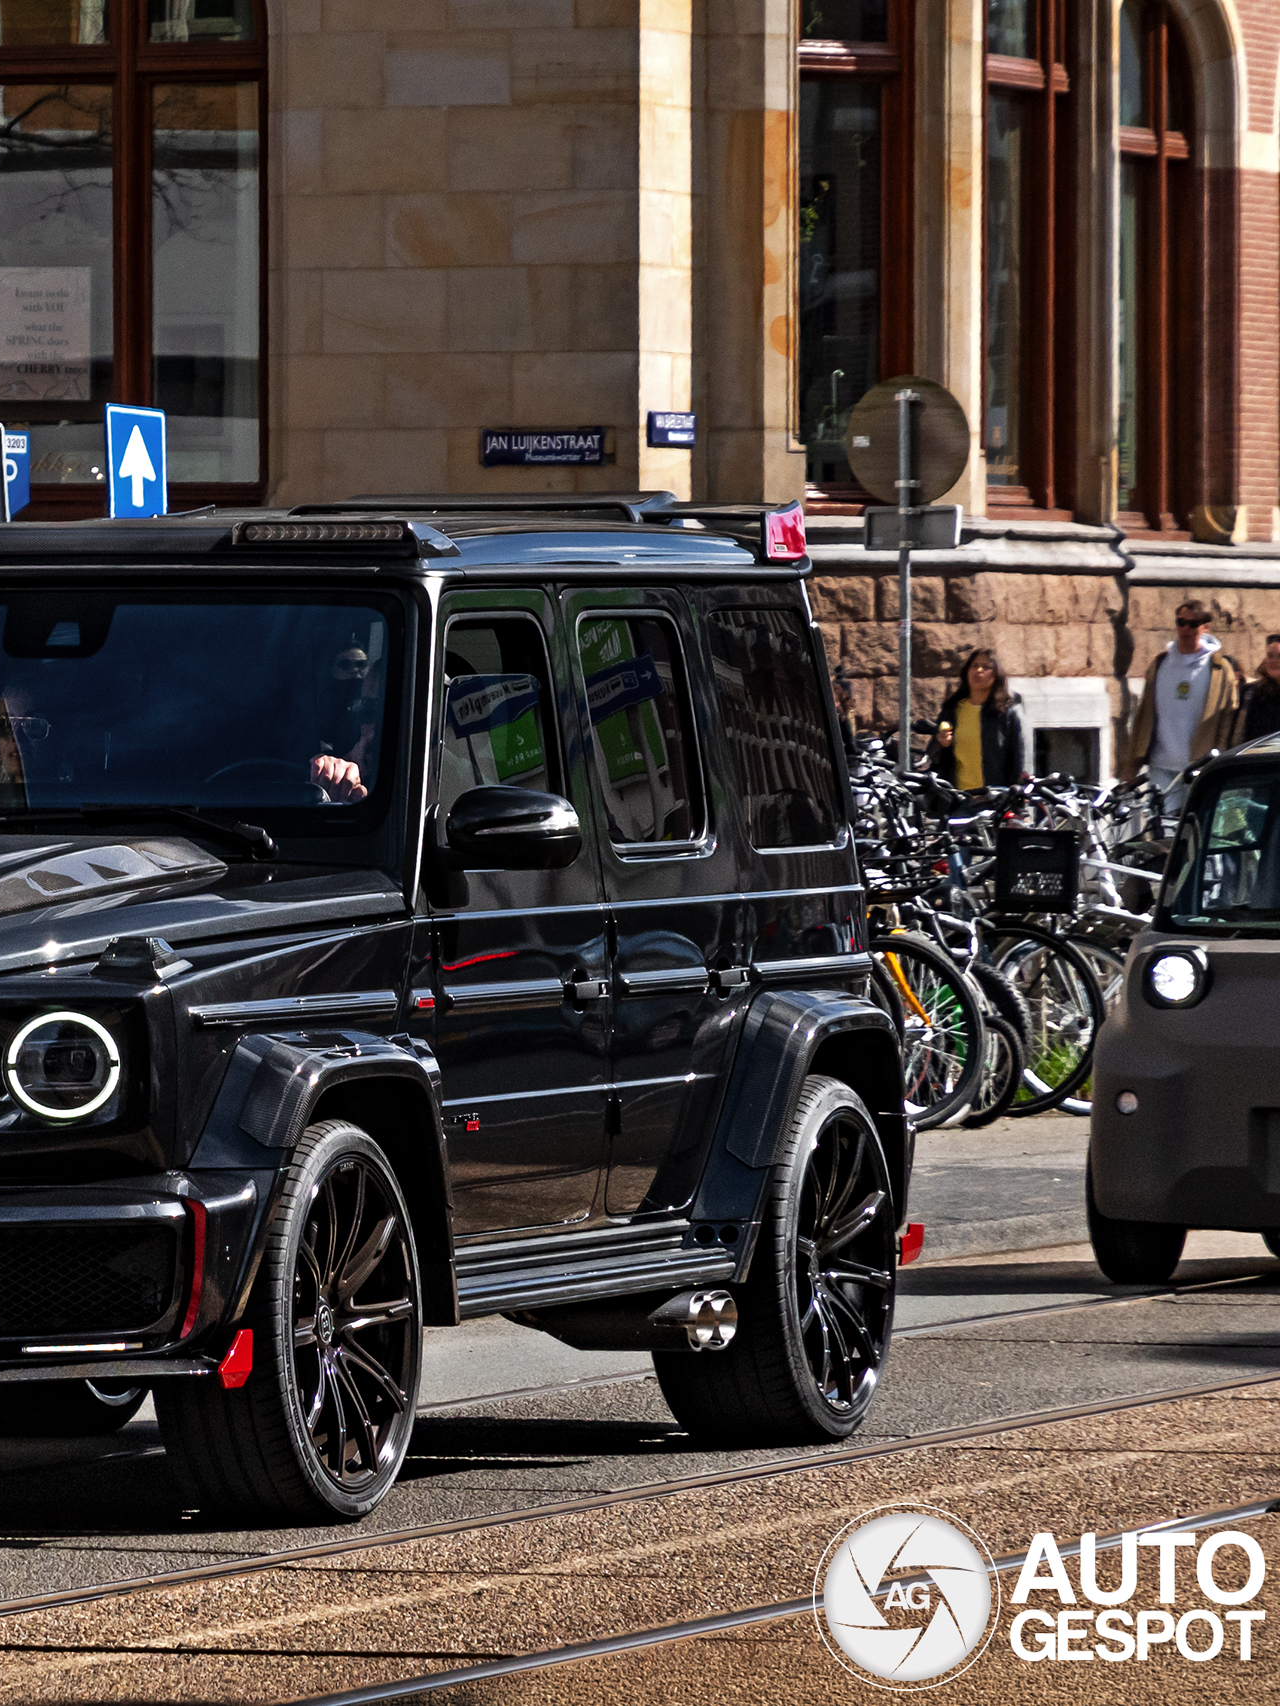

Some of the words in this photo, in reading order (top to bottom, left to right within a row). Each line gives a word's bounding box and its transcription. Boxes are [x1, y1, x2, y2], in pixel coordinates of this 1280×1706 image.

[17, 364, 61, 374] CHERRY
[6, 438, 26, 449] 3203
[486, 435, 508, 453] JAN
[511, 435, 600, 453] LUIJKENSTRAAT
[584, 452, 600, 460] Zuid
